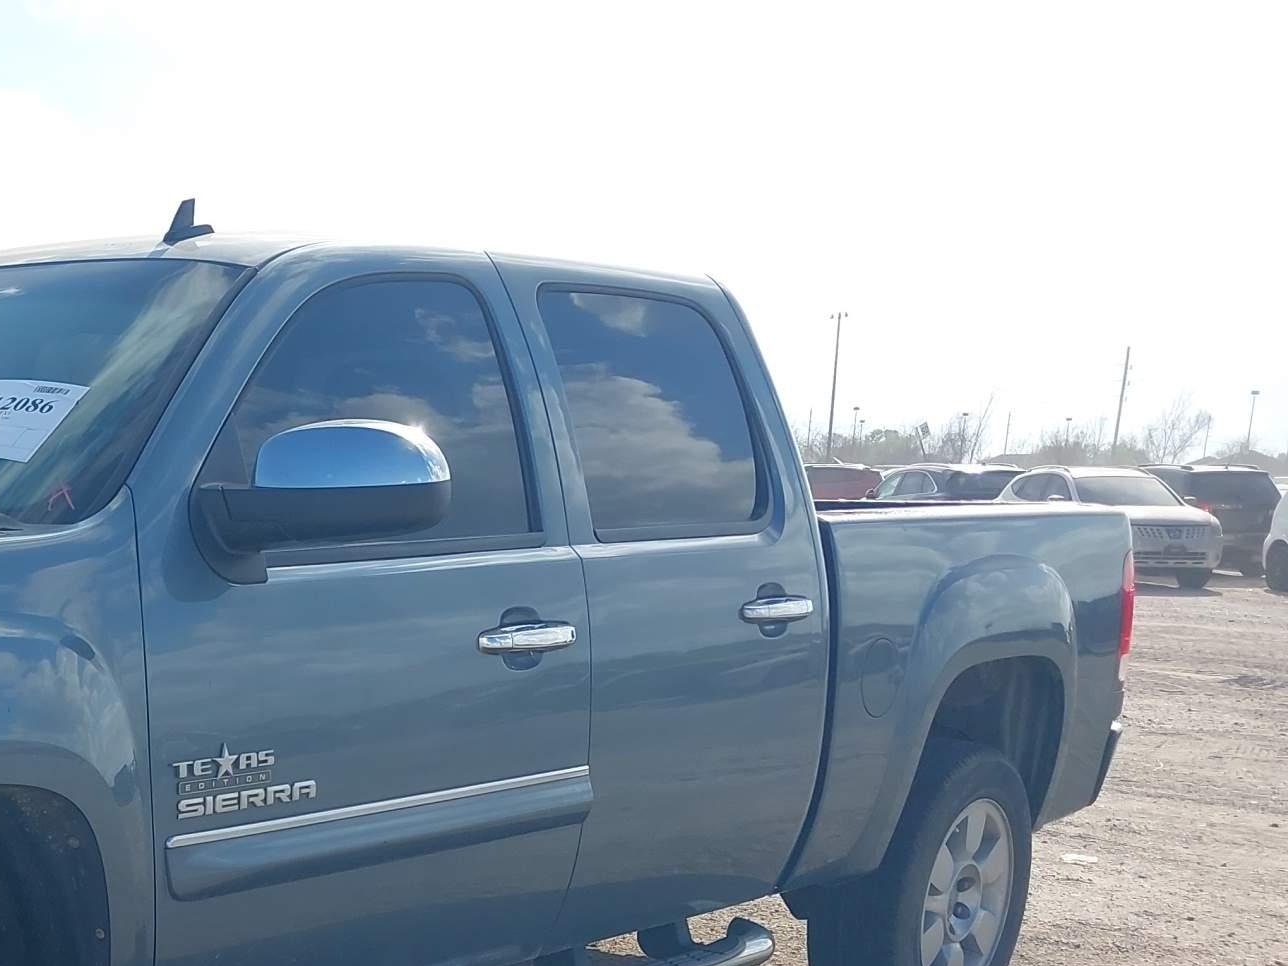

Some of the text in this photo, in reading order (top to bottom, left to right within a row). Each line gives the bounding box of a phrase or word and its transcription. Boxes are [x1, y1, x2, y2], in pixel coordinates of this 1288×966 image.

[171, 742, 275, 779] TEXAS
[177, 779, 317, 820] SIERRA
[185, 773, 267, 792] EDITION
